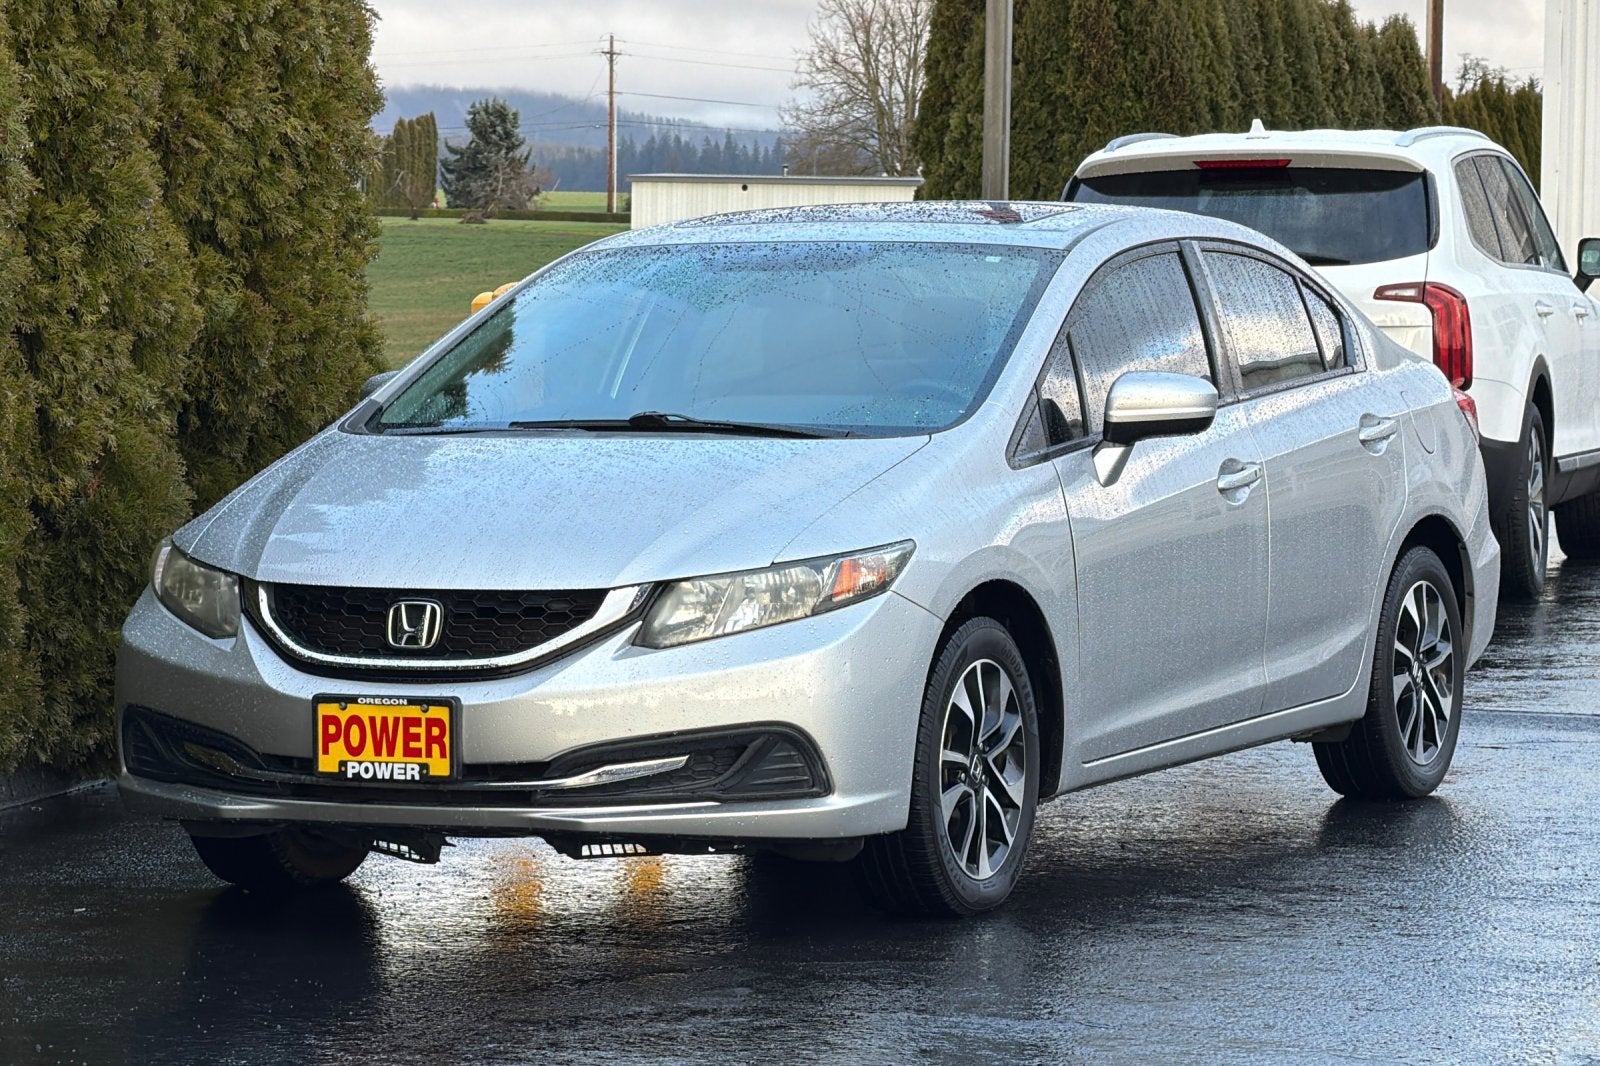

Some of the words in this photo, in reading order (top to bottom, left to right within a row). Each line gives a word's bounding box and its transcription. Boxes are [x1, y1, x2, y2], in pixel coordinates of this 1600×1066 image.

[357, 697, 408, 705] OREGON
[321, 714, 447, 759] POWER
[346, 761, 420, 780] POWER
